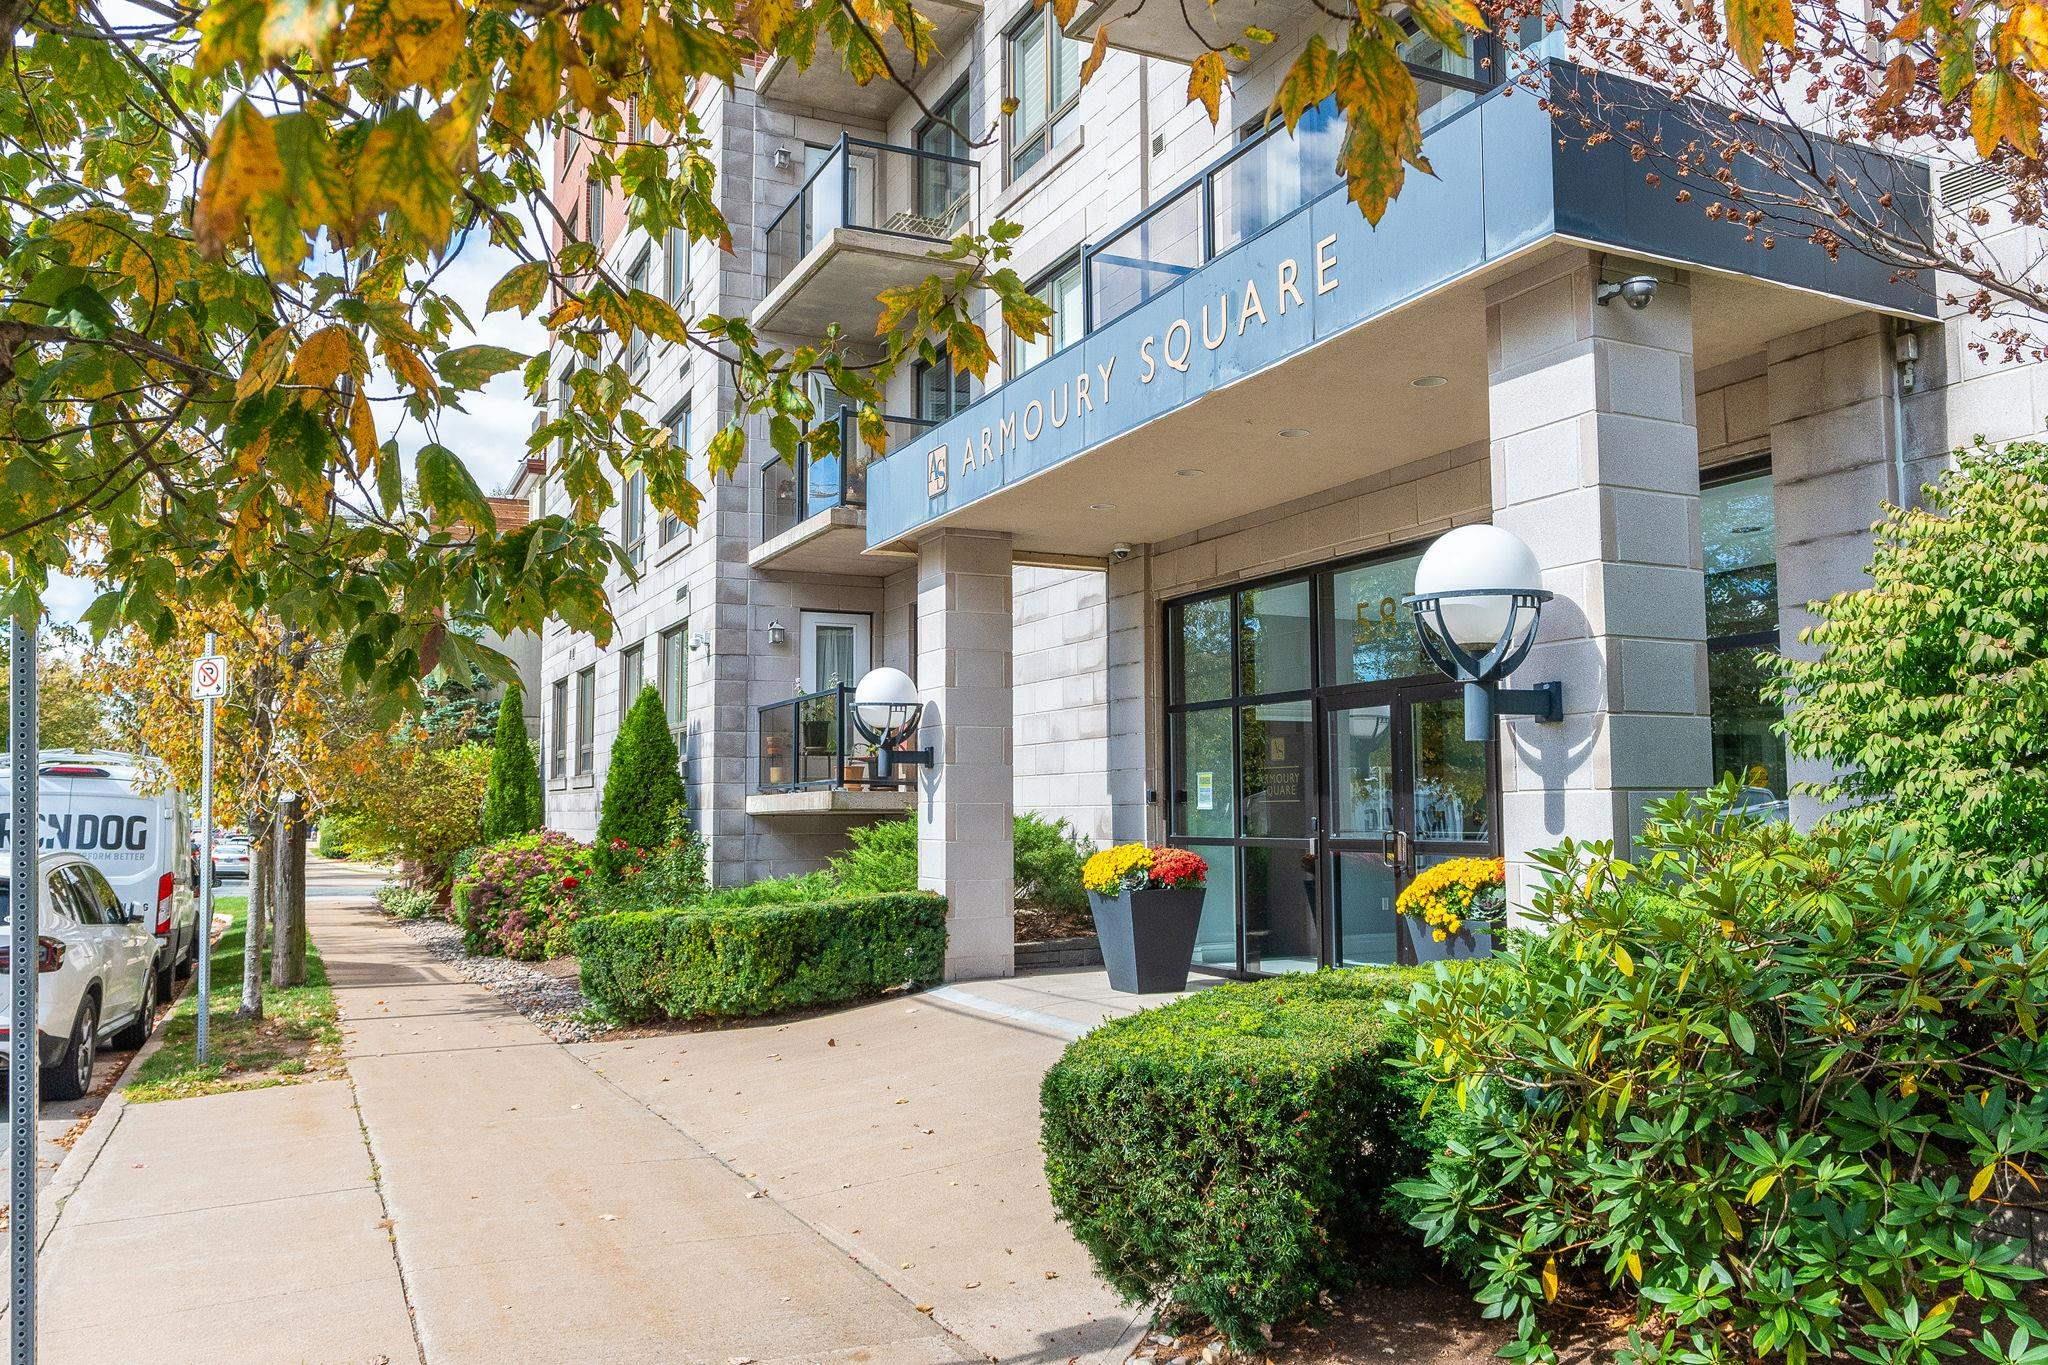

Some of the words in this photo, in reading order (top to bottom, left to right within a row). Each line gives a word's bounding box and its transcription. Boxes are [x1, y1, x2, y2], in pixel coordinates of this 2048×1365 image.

[962, 354, 1117, 477] ARMOURY
[1141, 232, 1340, 384] SQUARE
[1259, 773, 1300, 784] RMOURY
[1264, 785, 1296, 798] QUARE
[76, 814, 147, 850] DOG
[113, 852, 145, 861] BETTER
